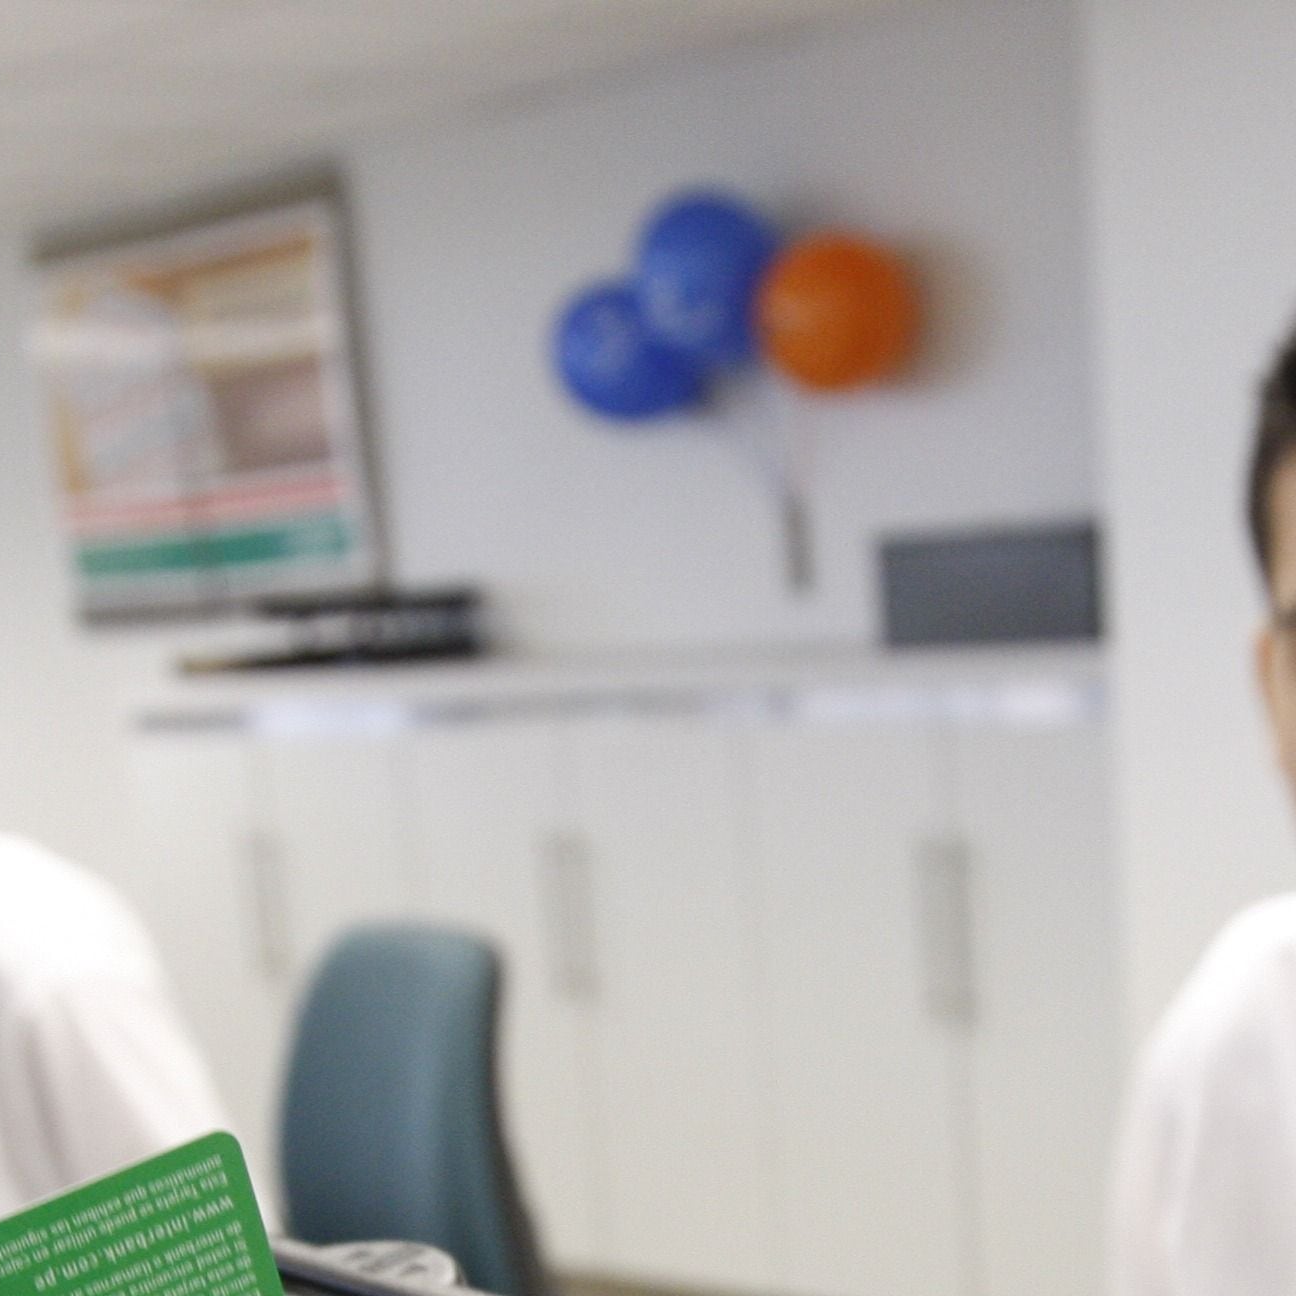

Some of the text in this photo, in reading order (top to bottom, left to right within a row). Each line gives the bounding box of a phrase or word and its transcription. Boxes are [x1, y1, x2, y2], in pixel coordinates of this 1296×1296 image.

[121, 1182, 147, 1206] que
[199, 1170, 228, 1194] Esta
[154, 1179, 200, 1214] Tarjeta
[98, 1209, 138, 1237] puede
[138, 1202, 155, 1220] se
[49, 1218, 71, 1238] las
[225, 1220, 242, 1238] de
[33, 1193, 234, 1296] www.interbank.com.pe
[52, 1226, 97, 1257] utilizar
[163, 1227, 224, 1265] Interbank
[32, 1246, 50, 1264] en
[195, 1243, 231, 1270] usted
[235, 1254, 252, 1272] de
[206, 1261, 235, 1285] esta
